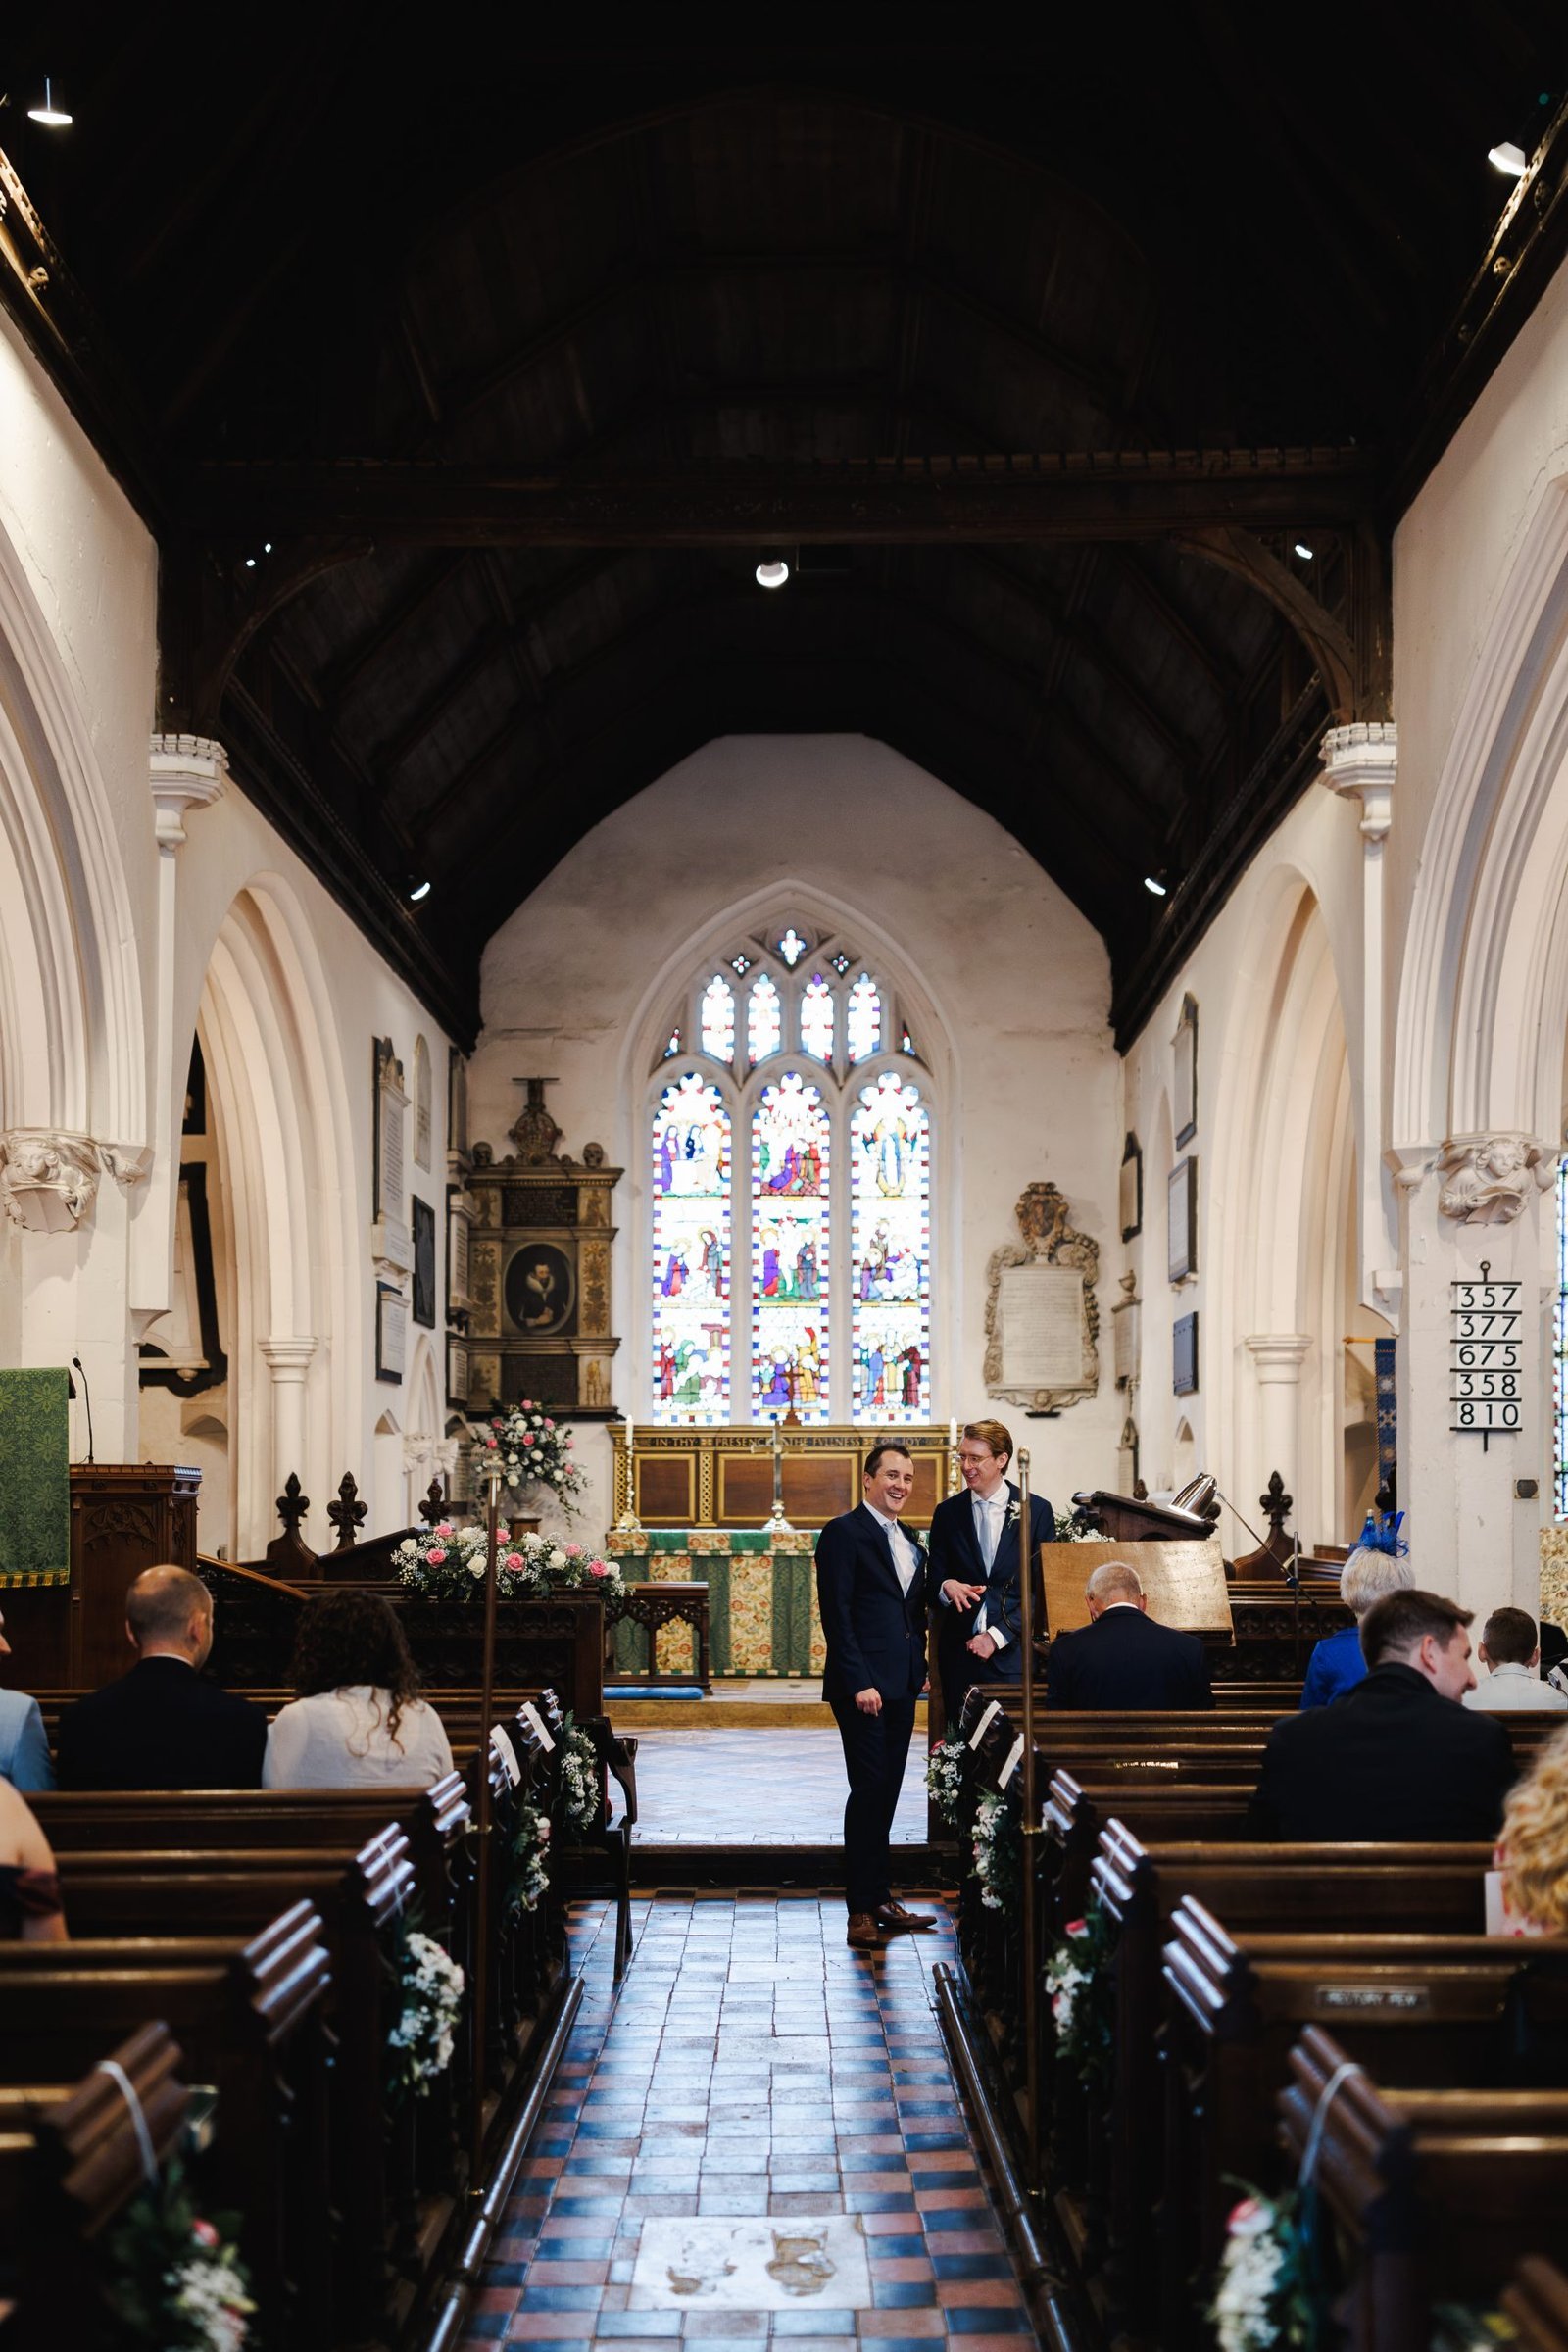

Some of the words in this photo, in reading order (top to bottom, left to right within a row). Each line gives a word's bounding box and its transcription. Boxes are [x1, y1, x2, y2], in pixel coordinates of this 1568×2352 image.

[1461, 1287, 1517, 1307] 357
[1461, 1315, 1517, 1337] 377
[1459, 1345, 1516, 1366] 675
[1460, 1374, 1515, 1396] 358
[1460, 1403, 1518, 1426] 810
[656, 1437, 668, 1446] IN
[672, 1437, 694, 1446] THY
